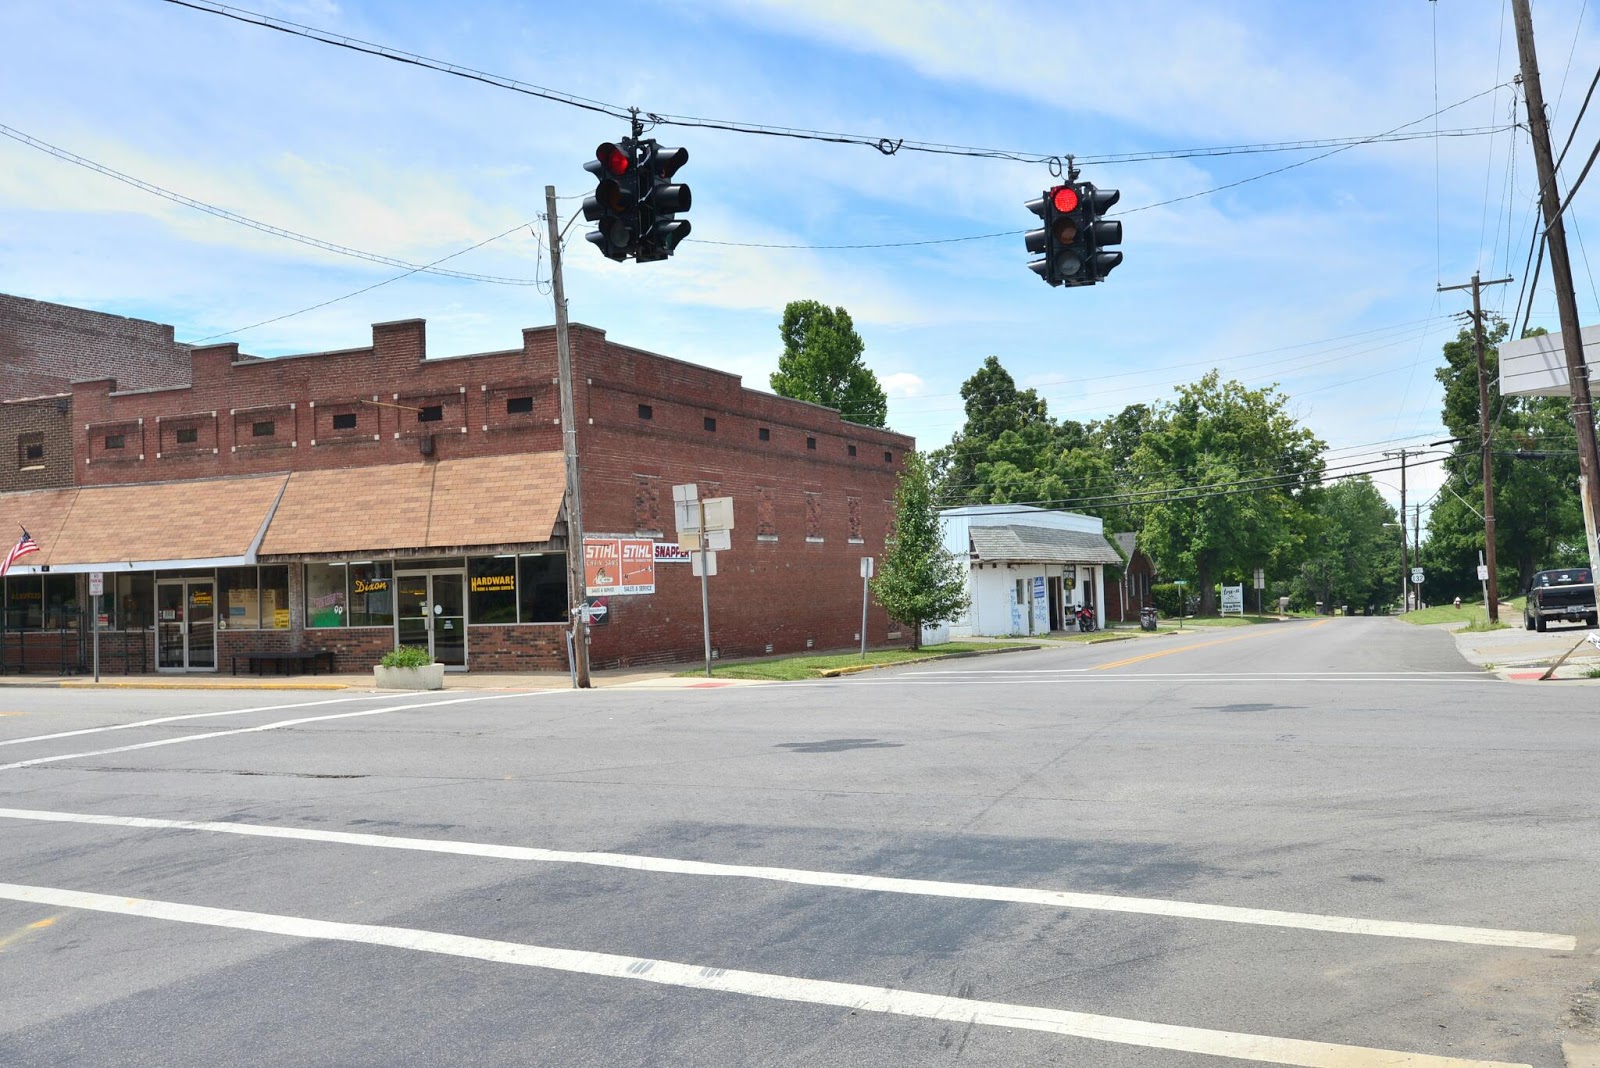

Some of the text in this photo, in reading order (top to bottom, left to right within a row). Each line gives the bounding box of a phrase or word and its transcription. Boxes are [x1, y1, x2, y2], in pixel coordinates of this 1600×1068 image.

[586, 545, 618, 558] STIHL
[623, 545, 651, 558] STIHL
[354, 580, 387, 593] Dixon
[471, 575, 514, 592] HARDWARE
